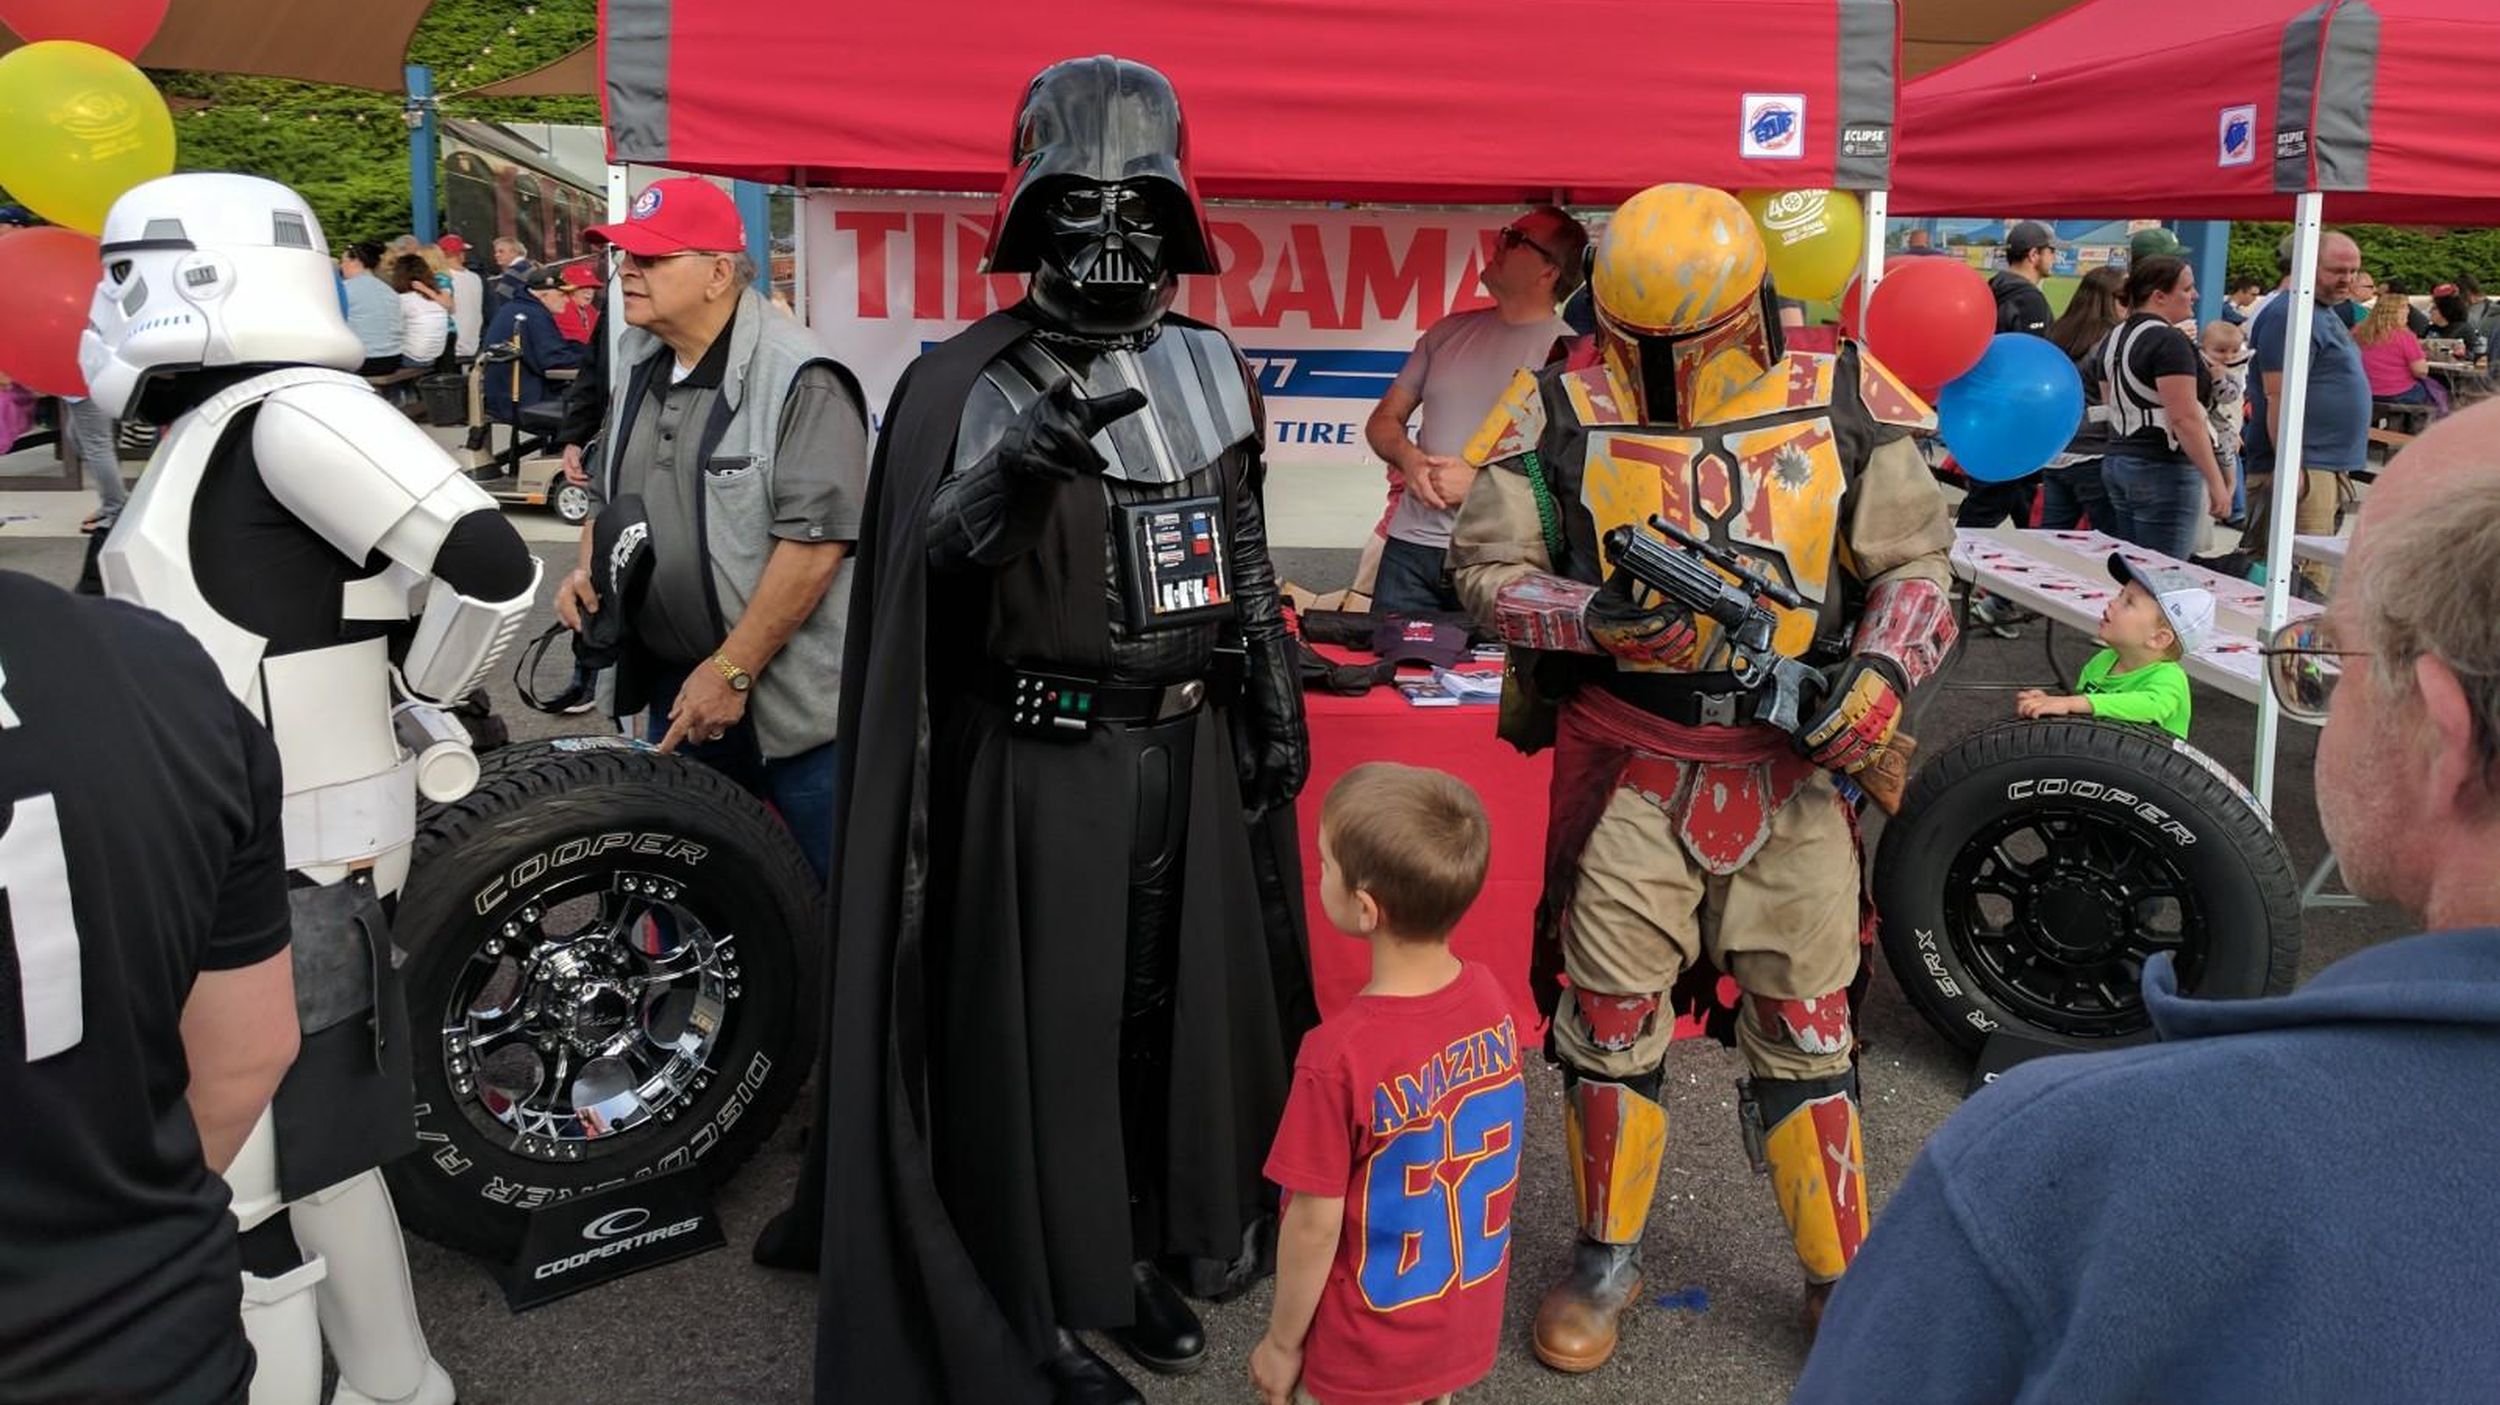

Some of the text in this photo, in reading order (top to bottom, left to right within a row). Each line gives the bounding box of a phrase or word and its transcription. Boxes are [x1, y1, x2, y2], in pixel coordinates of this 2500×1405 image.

[1844, 129, 1885, 142] ECLIPSE
[1246, 357, 1298, 389] 77
[1273, 421, 1358, 445] TIRE
[2007, 778, 2197, 846] COOPER
[474, 832, 709, 916] COOPER
[1371, 1013, 1518, 1137] AMAZIN
[1356, 1072, 1527, 1313] 62
[534, 1215, 704, 1280] COOPERTIRES
